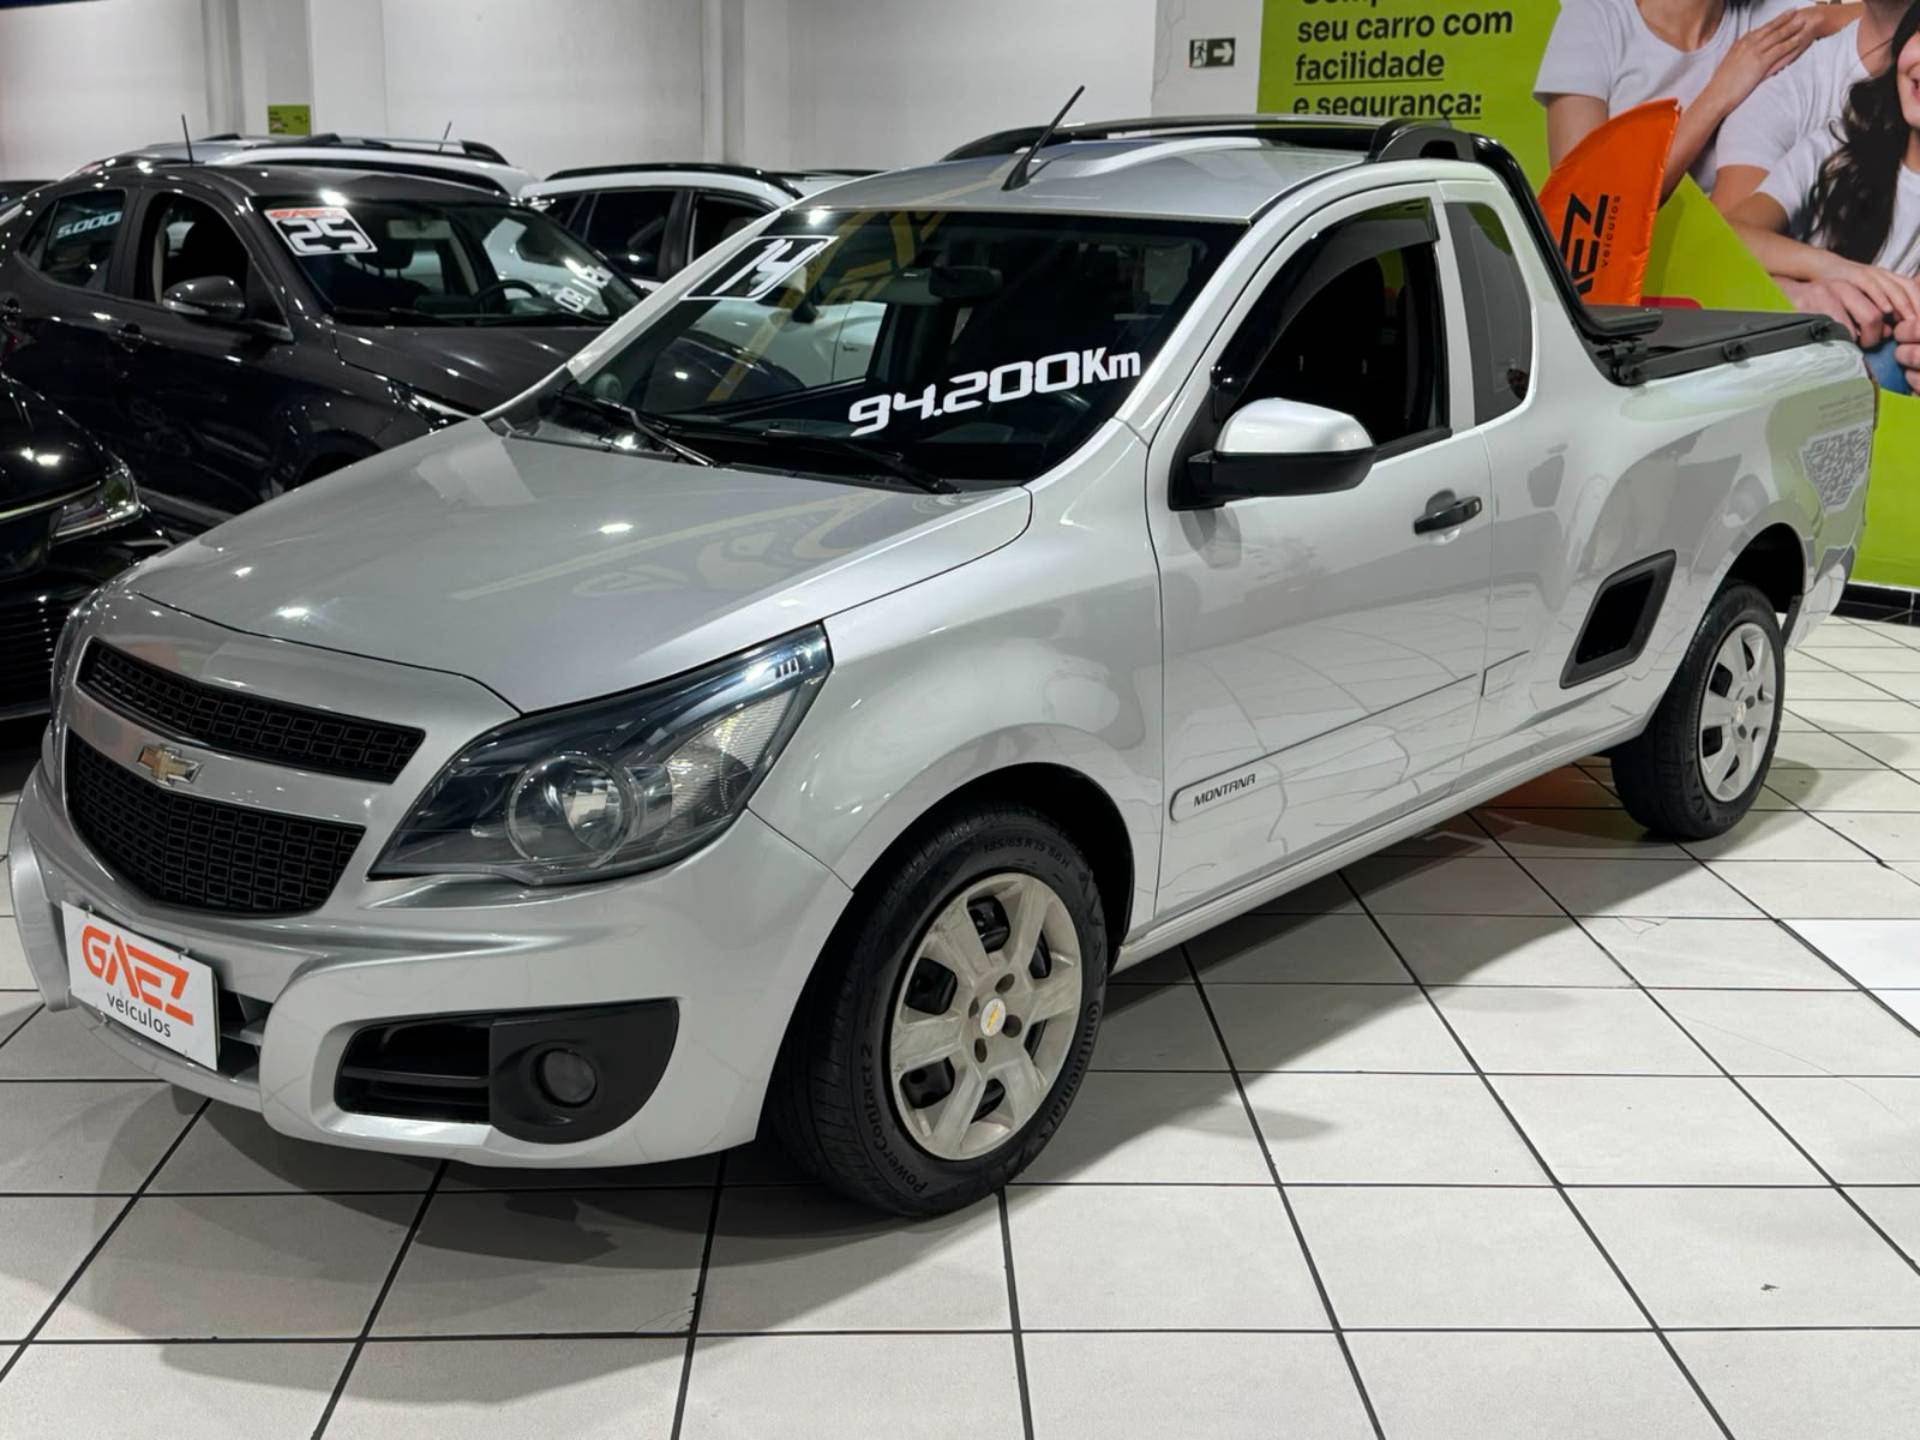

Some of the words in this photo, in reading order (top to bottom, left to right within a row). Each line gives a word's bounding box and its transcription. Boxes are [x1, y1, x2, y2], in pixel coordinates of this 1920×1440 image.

[1297, 19, 1348, 43] seu
[1355, 14, 1435, 40] carro
[1443, 10, 1513, 36] com
[1295, 49, 1445, 81] facilidade
[1293, 97, 1309, 114] e
[281, 219, 369, 252] 25
[711, 239, 825, 297] 14
[848, 347, 1141, 437] 94.200Km
[1193, 773, 1256, 807] MONTANA
[82, 925, 194, 1026] GAEZ
[860, 1043, 873, 1058] 2
[861, 1064, 929, 1194] PowerContact
